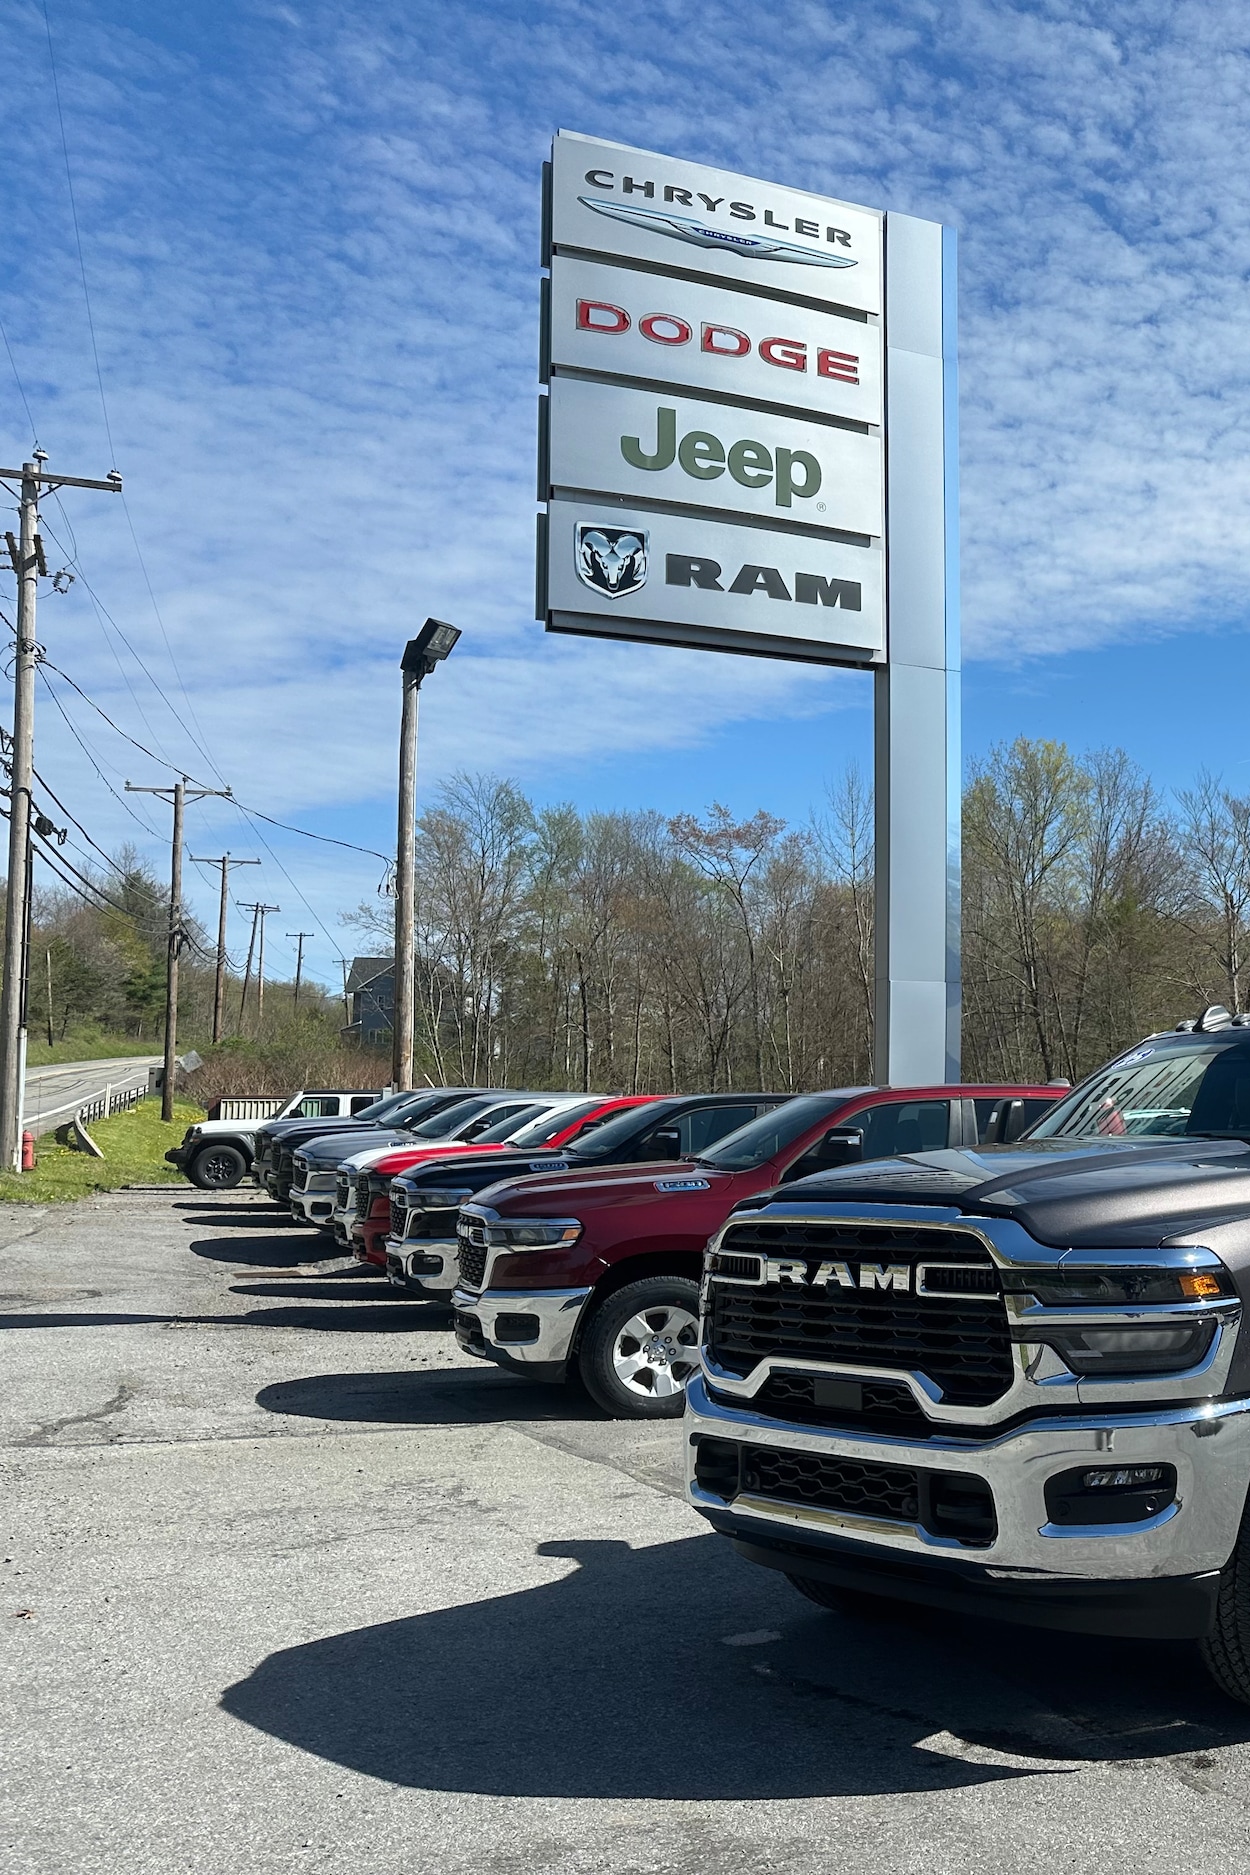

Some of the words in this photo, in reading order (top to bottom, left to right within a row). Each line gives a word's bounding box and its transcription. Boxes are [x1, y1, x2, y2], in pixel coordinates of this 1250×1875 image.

[585, 169, 852, 248] CHRYSLER
[698, 229, 752, 246] CHRYSLER
[576, 298, 859, 385] DODGE
[621, 407, 822, 508] Jeep
[665, 553, 862, 612] RAM
[767, 1257, 910, 1292] RAM
